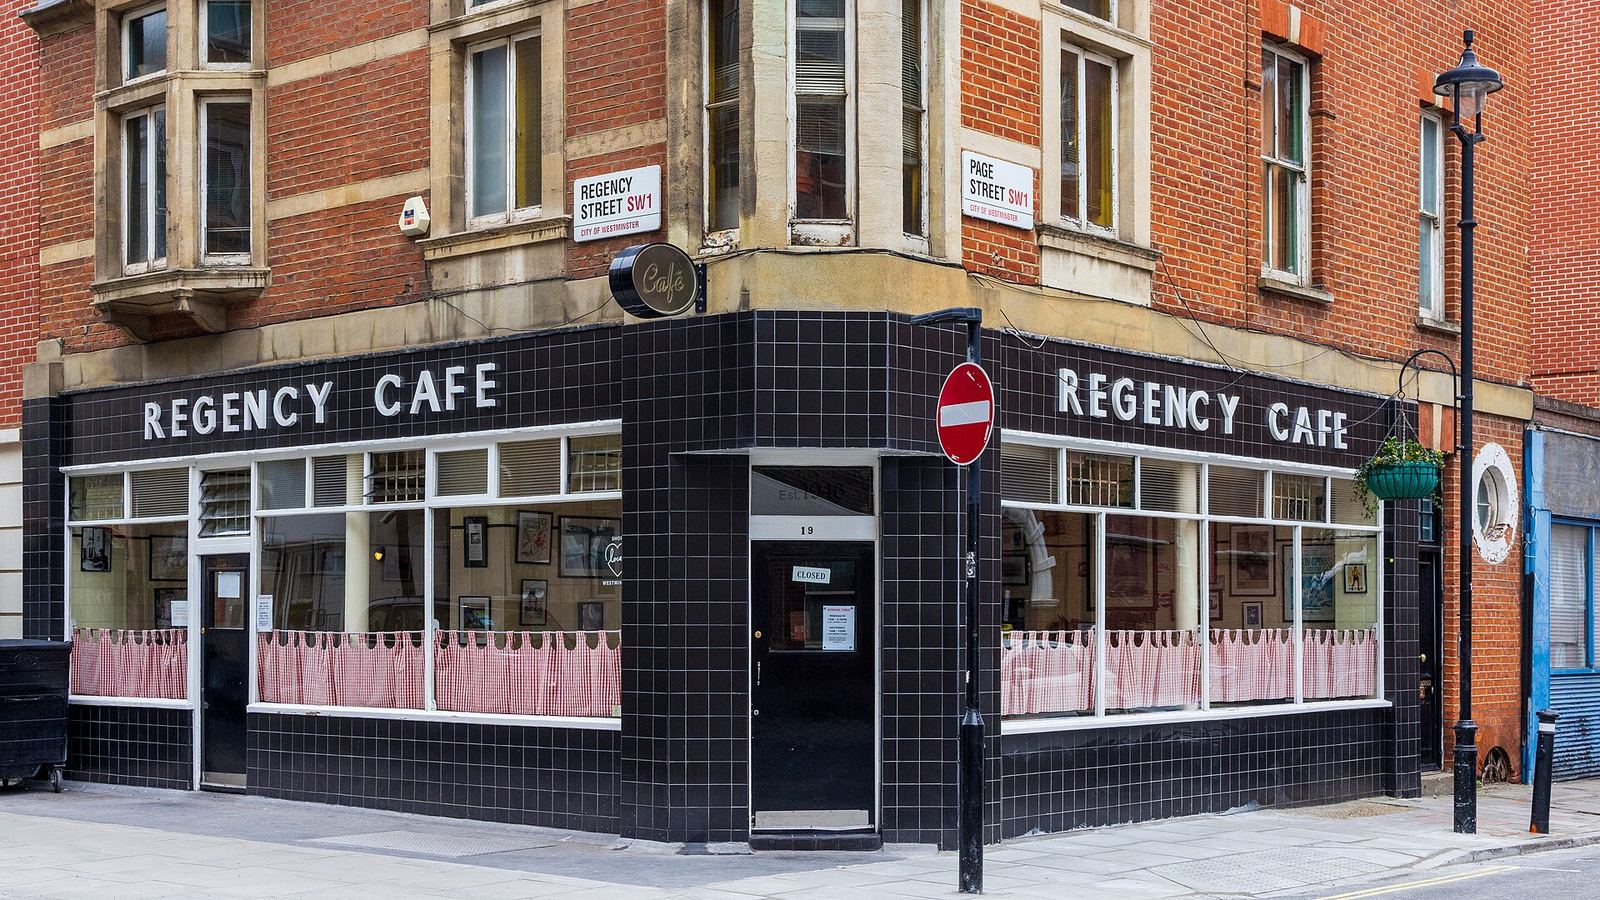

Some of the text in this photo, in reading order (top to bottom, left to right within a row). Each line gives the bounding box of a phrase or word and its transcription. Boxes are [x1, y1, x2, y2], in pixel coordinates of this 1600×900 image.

[970, 159, 994, 179] PAGE
[581, 176, 633, 201] REGENCY
[970, 179, 1028, 208] STREET SW1
[581, 193, 652, 220] STREET SW1
[970, 204, 1018, 222] CITY OF WESTMINSTER
[580, 220, 640, 237] CITY OF WESTMINSTER
[642, 262, 685, 304] Café
[144, 362, 496, 440] REGENCY CAFE
[1058, 368, 1348, 450] REGENCY CAFE
[779, 489, 801, 500] Est.
[800, 526, 814, 535] 19
[796, 570, 826, 580] CLOSED
